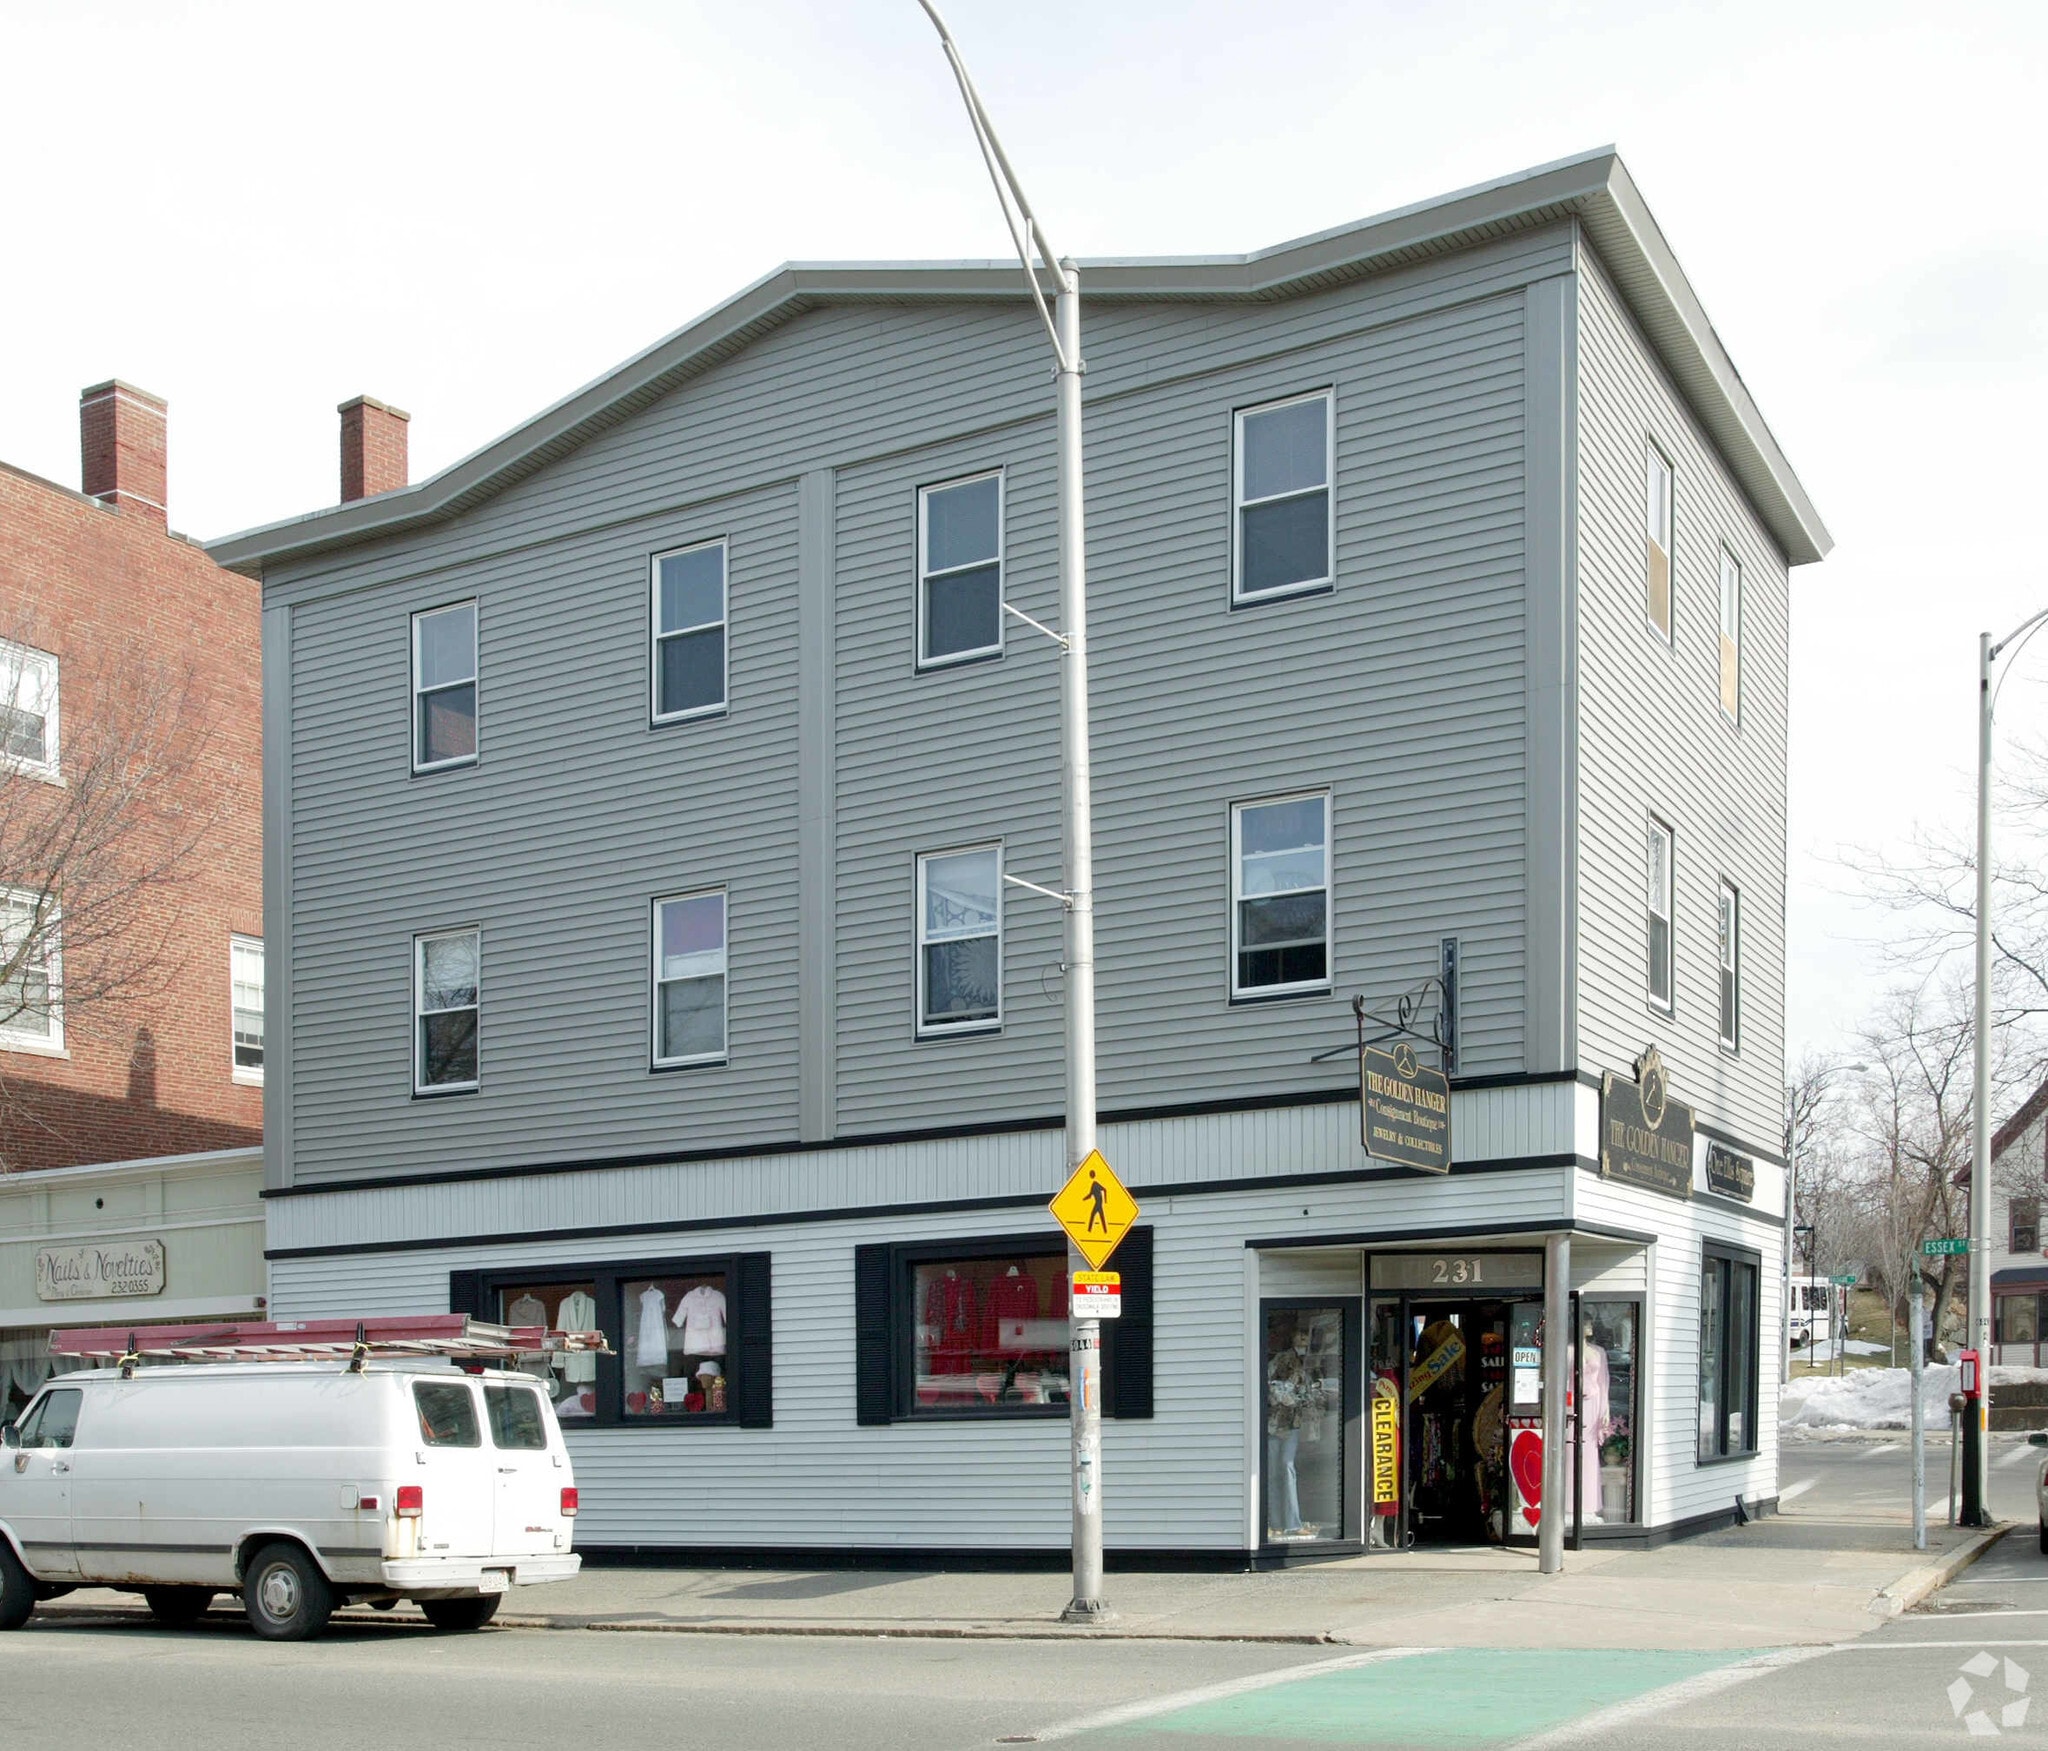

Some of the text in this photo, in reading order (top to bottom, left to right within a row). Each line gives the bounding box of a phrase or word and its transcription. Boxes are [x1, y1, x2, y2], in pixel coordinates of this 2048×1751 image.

[1367, 1070, 1446, 1114] THE GOLDEN HANGER
[1610, 1119, 1689, 1169] THE GOLDEN HANGER
[1925, 1241, 1955, 1254] ESSEX
[45, 1253, 80, 1284] Nails
[94, 1250, 153, 1281] Novelties
[1432, 1259, 1483, 1283] 231
[1085, 1285, 1109, 1293] YIELD
[1515, 1351, 1537, 1364] OPEN
[1375, 1399, 1393, 1501] CLEARANCE
